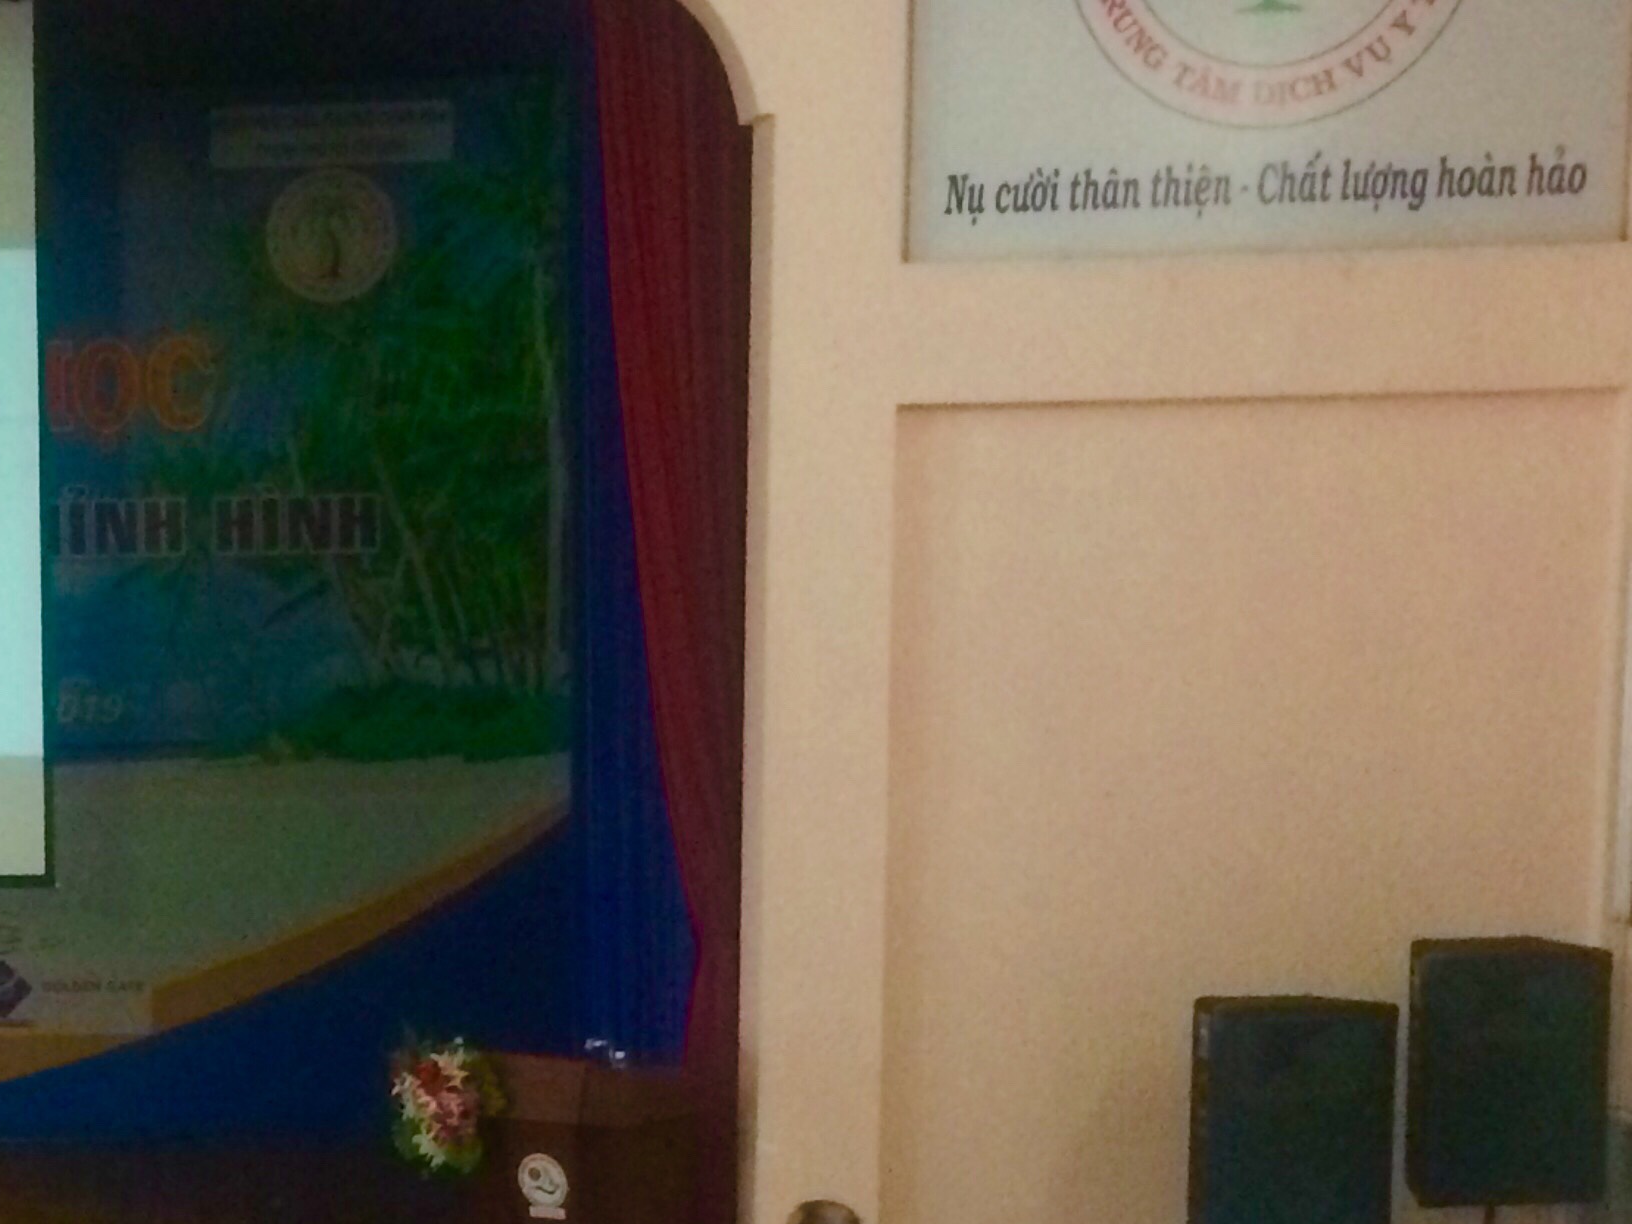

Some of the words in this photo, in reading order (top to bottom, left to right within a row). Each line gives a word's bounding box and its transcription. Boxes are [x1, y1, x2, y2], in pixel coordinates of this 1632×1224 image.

[943, 172, 985, 226] Nụ
[995, 166, 1060, 215] cười
[1069, 167, 1141, 212] thân
[1151, 161, 1232, 219] thiện
[1257, 151, 1331, 205] Chất
[1341, 157, 1429, 212] lượng
[1437, 151, 1517, 198] hoàn
[1527, 145, 1588, 197] hảo
